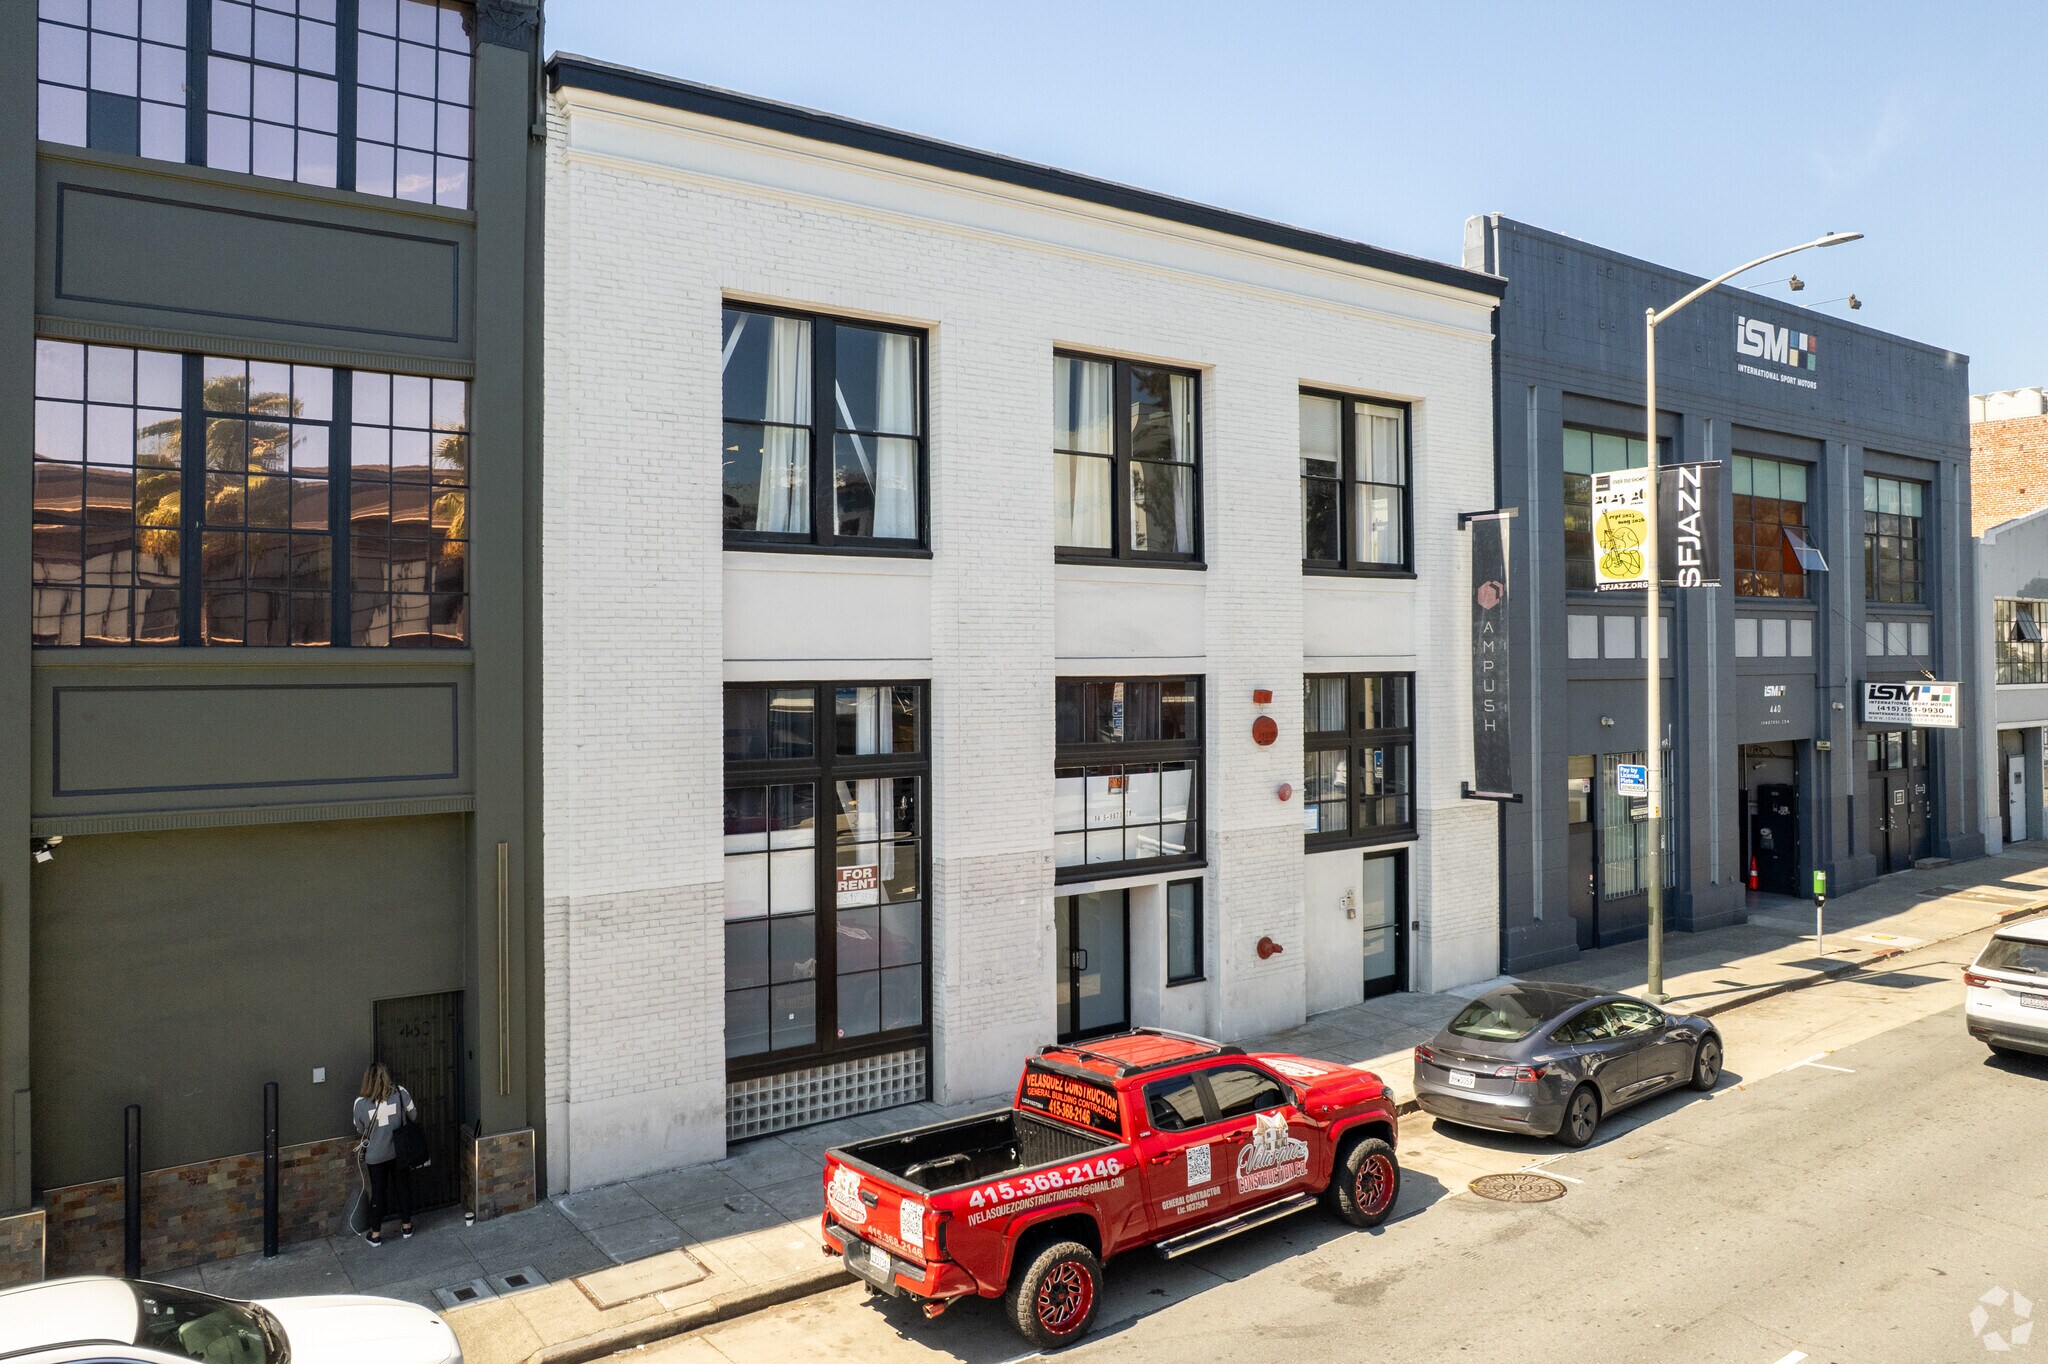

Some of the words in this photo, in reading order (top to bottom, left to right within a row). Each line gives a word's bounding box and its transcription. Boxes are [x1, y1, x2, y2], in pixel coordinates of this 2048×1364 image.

[1737, 363, 1780, 381] INTERNATIONAL
[1780, 374, 1796, 385] SPORT
[1797, 378, 1817, 390] MOTORS
[1678, 465, 1701, 588] SFJAZZ
[1600, 581, 1648, 591] SFJAZZ.ORG
[1483, 621, 1496, 731] AMPUSH
[1769, 704, 1782, 713] 440
[1902, 706, 1944, 714] 551-9930
[1630, 767, 1638, 775] by
[837, 878, 877, 891] RENT
[842, 868, 873, 880] FOR
[1026, 1074, 1063, 1092] VELASQUEZ
[1064, 1078, 1117, 1112] CONSTRUCTION
[1027, 1087, 1051, 1098] GENERAL
[1051, 1091, 1077, 1105] BUILDING
[1077, 1098, 1117, 1122] CONTRACTOR
[1048, 1099, 1091, 1125] 415-368-2146
[1238, 1141, 1308, 1175] Velasquez
[969, 1157, 1121, 1208] 415.368.2146
[968, 1177, 1125, 1227] IVELASQUEZCONSTRUCTION564@GMAIL.COM
[1161, 1194, 1185, 1210] GENERAL
[1185, 1186, 1221, 1204] CONTRACTOR
[867, 1225, 924, 1258] 415.368.2146
